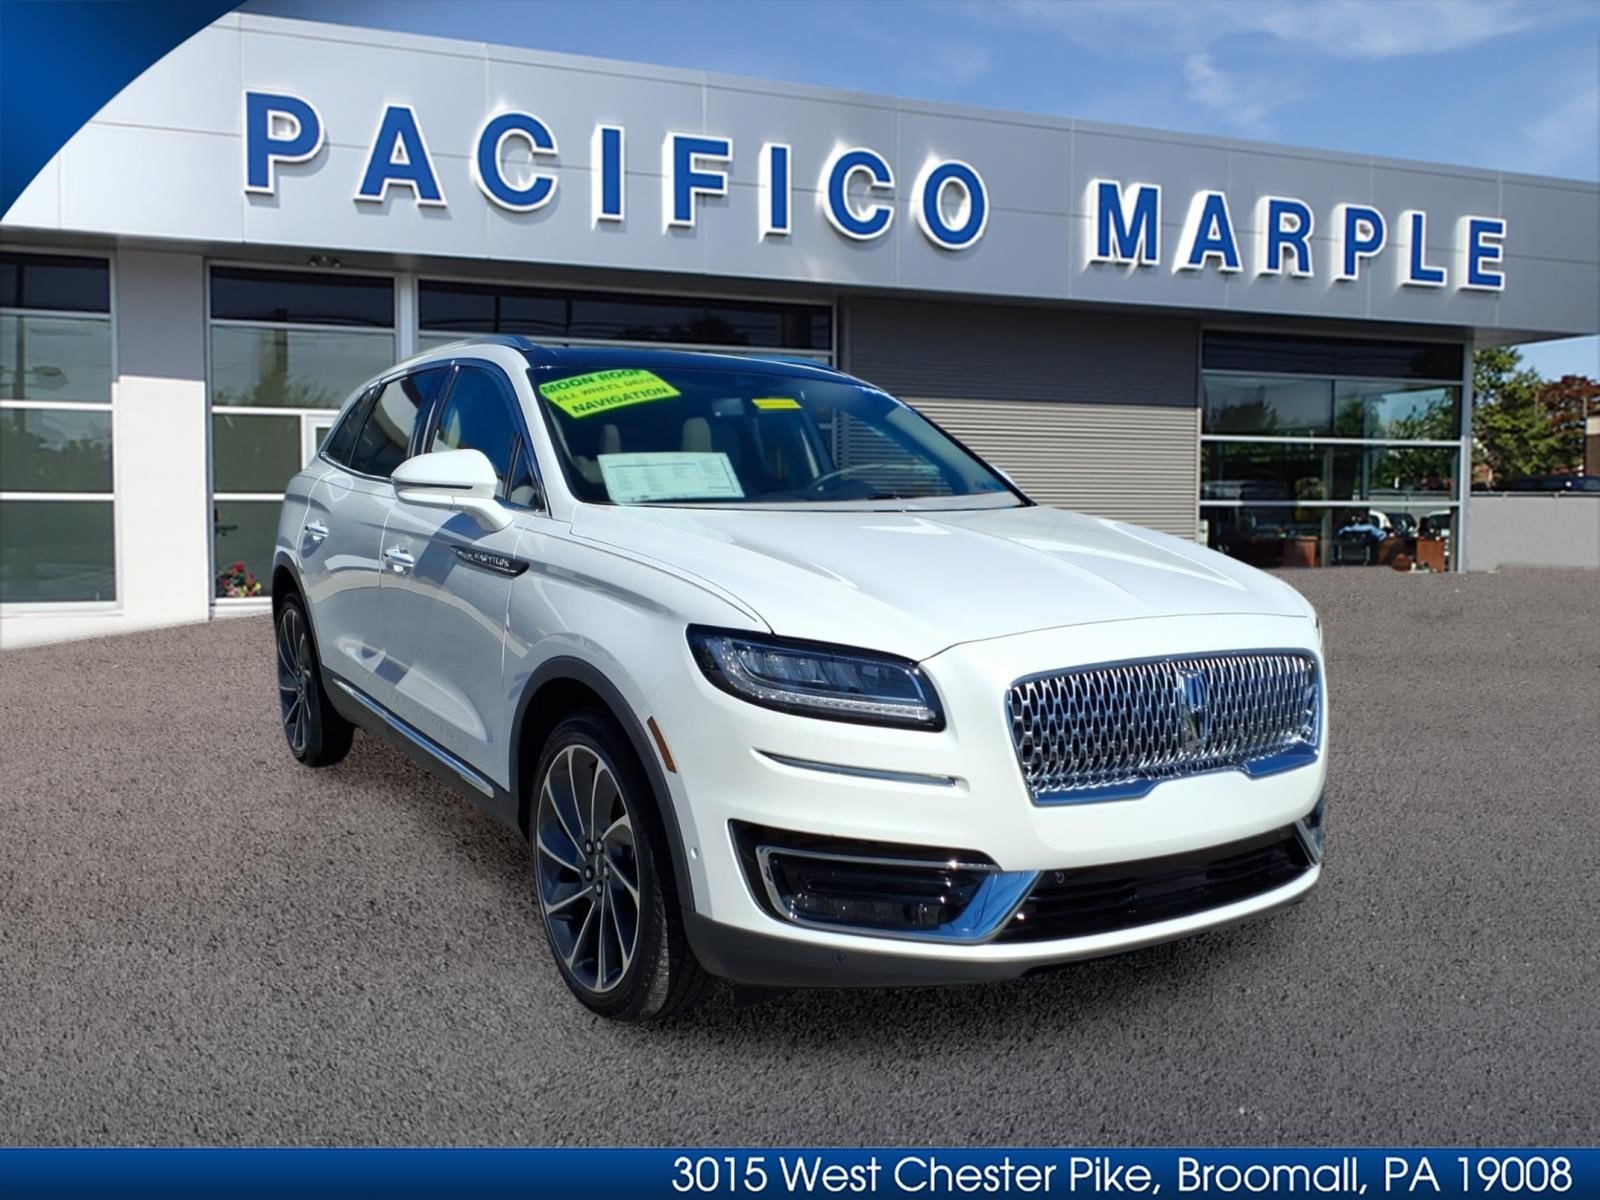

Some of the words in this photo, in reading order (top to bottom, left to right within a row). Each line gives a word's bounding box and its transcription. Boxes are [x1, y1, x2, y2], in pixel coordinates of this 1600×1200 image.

[243, 90, 989, 250] PACIFICO
[1088, 178, 1506, 293] MARPLE
[541, 376, 595, 394] MOON
[571, 386, 670, 413] NAVIGATION
